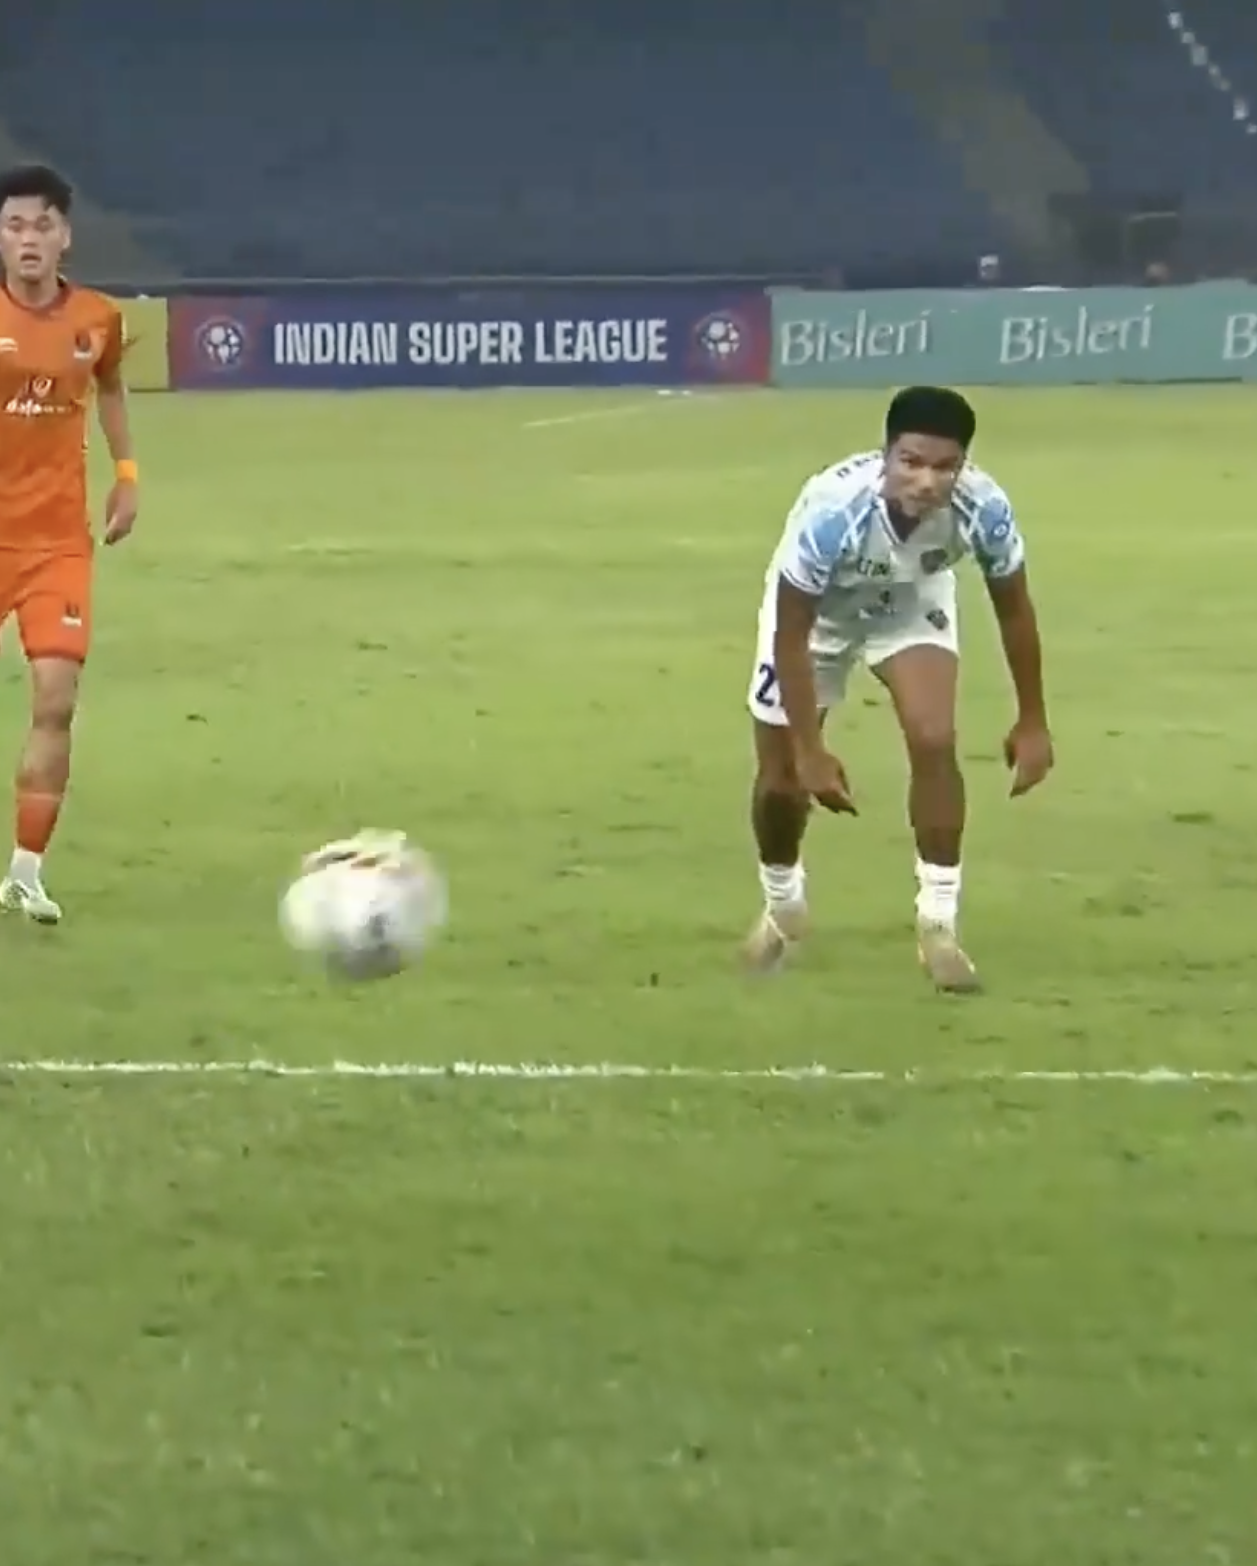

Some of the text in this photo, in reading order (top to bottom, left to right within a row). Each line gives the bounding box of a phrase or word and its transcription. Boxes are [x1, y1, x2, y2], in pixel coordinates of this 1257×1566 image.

[275, 319, 668, 365] INDIAN SUPER LEAGUE
[781, 309, 932, 365] Bisleri
[1000, 304, 1155, 363] Bisleri
